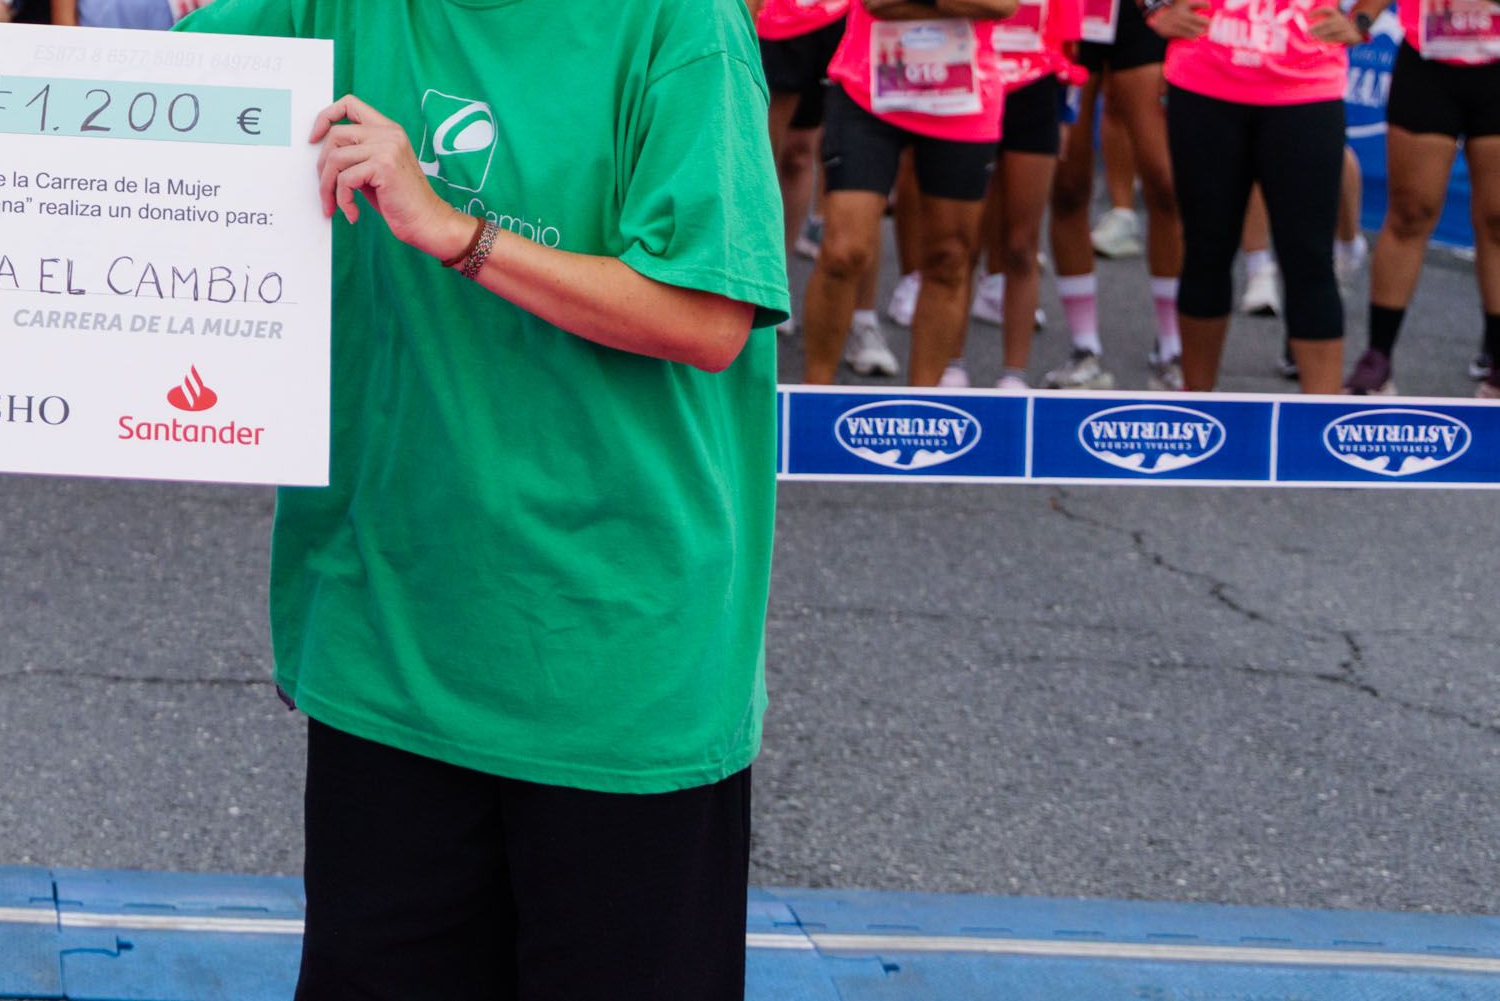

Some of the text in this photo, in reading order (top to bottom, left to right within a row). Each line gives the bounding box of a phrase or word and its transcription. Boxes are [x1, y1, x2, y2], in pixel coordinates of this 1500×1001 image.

[236, 107, 262, 135] €
[13, 171, 29, 188] la
[36, 172, 108, 192] Carrera
[114, 176, 137, 193] de
[144, 177, 160, 194] la
[167, 179, 221, 201] Mujer
[39, 199, 102, 217] realiza
[108, 205, 132, 218] un
[138, 203, 219, 223] donativo
[225, 210, 274, 227] para:
[40, 258, 86, 295] EL
[13, 309, 284, 340] CARRERA DE LA MUJER
[118, 415, 265, 445] Santander
[846, 417, 972, 446] ASTURIANA
[1090, 421, 1216, 450] ASTURIANA
[1334, 424, 1462, 452] ASTURIANA
